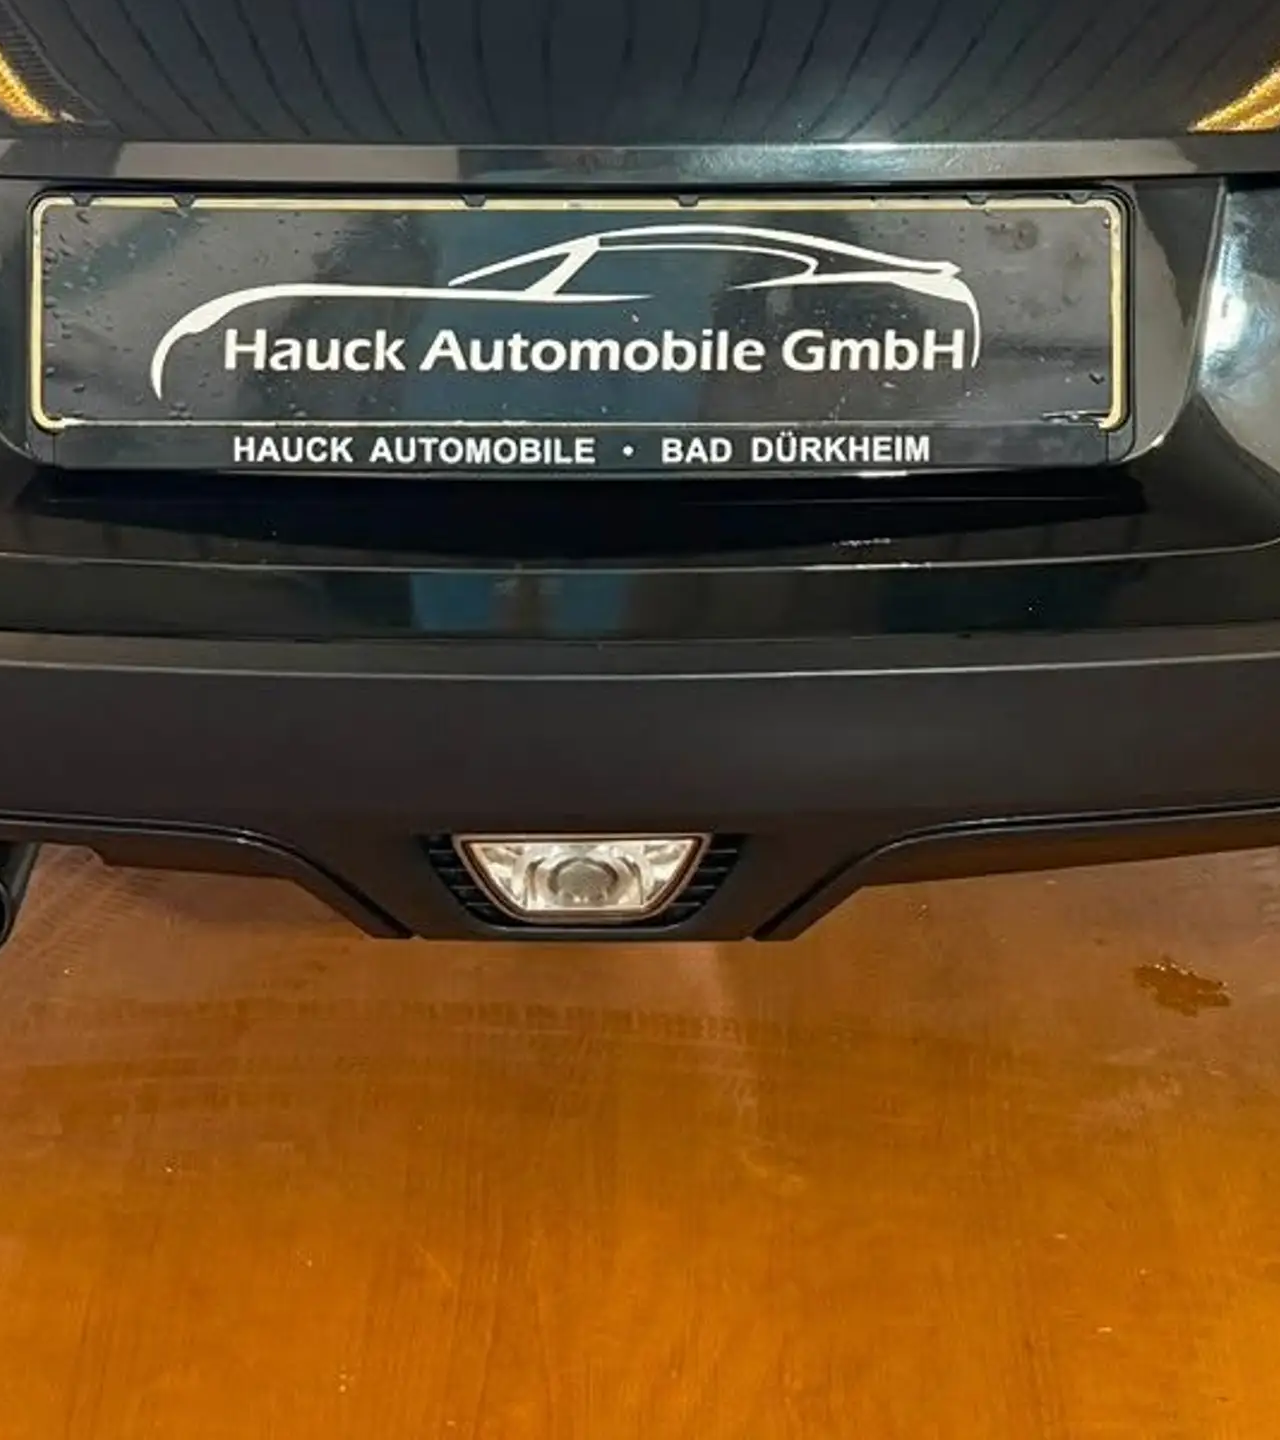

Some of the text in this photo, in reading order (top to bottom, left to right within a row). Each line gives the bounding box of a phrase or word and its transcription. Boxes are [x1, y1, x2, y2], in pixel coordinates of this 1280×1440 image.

[223, 328, 966, 372] Hauck Automobile GmbH
[232, 430, 931, 465] HAUCK AUTOMOBILE BAD DÜRKHEIM
